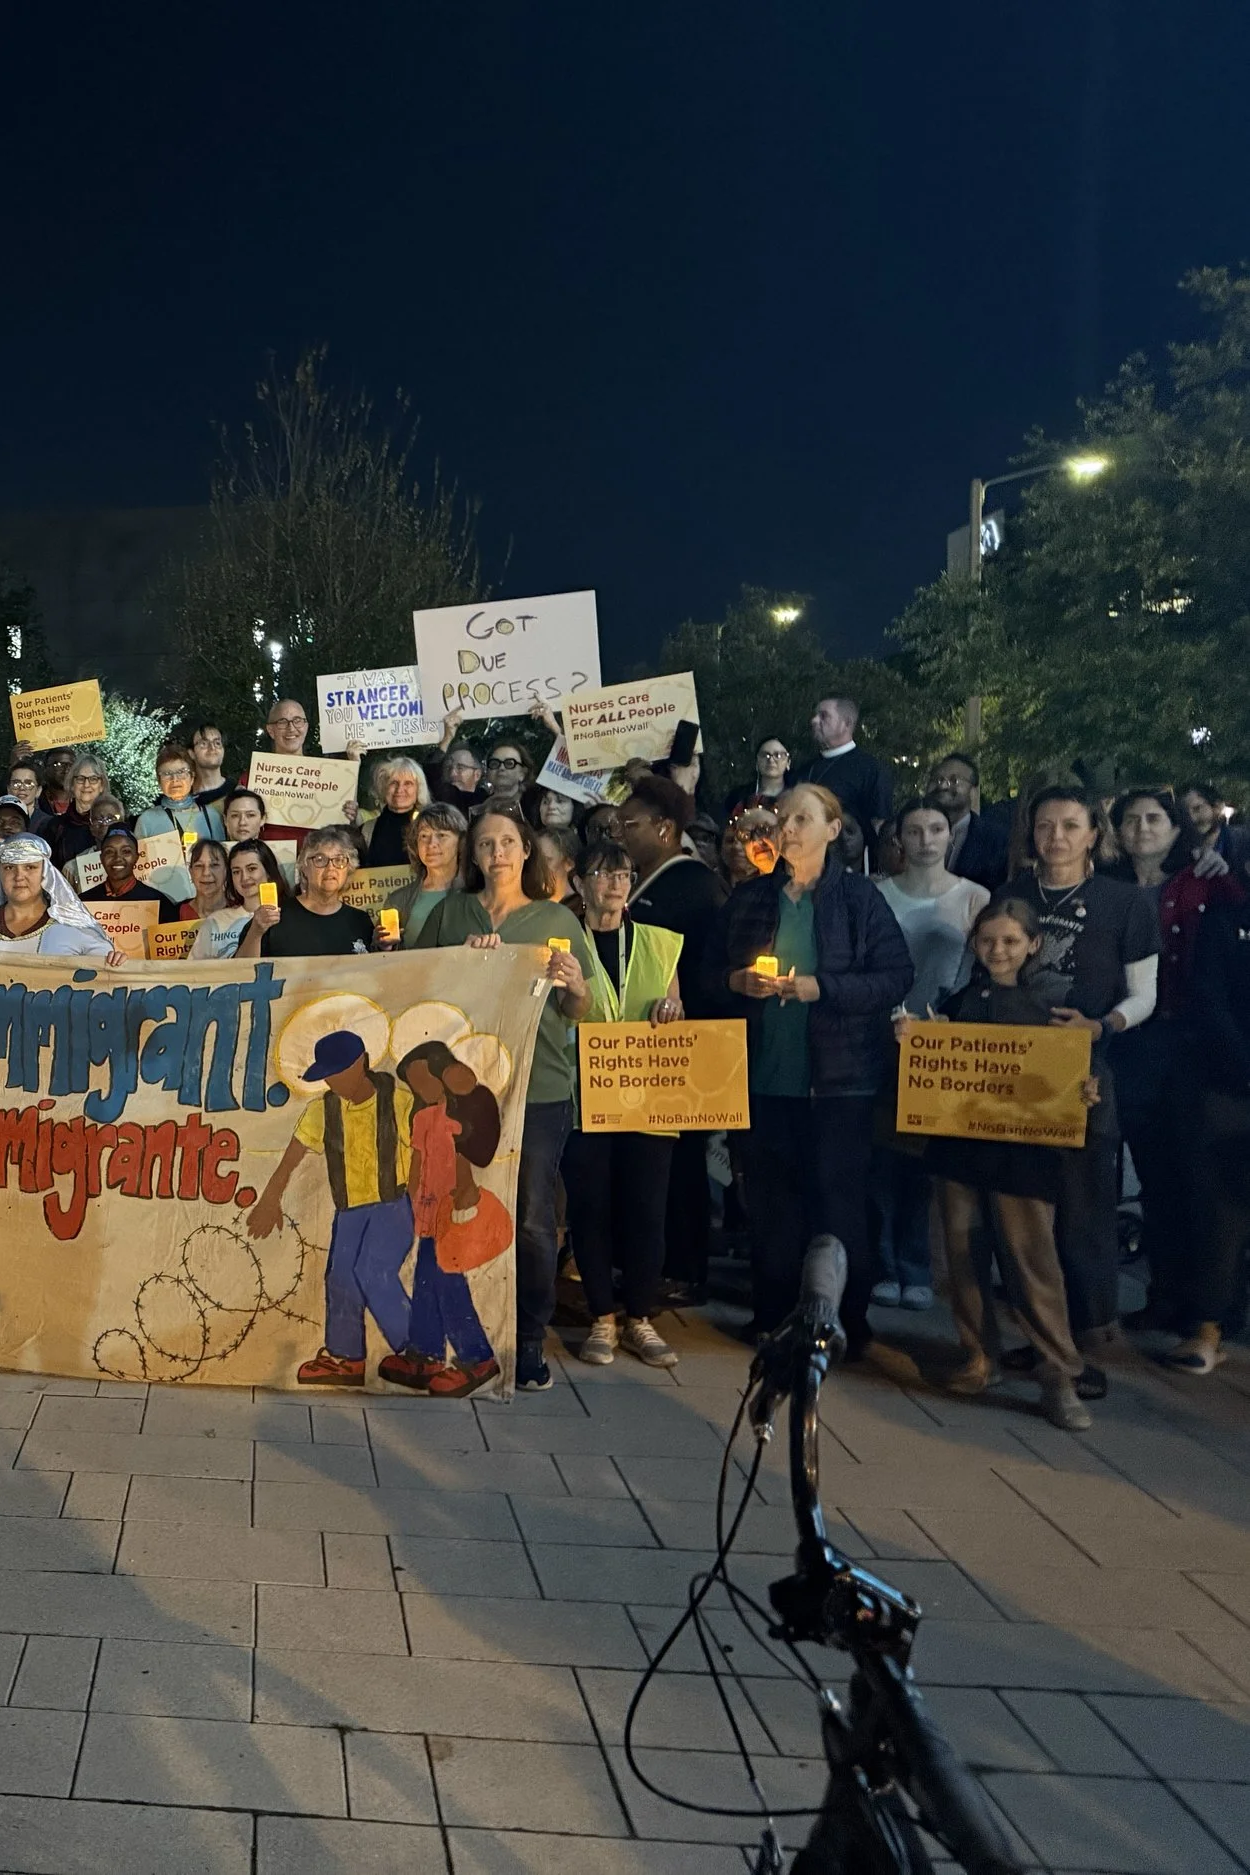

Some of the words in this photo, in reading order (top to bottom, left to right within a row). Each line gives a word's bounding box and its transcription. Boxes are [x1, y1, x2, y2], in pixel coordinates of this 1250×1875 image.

[466, 611, 538, 640] GOT
[458, 650, 507, 674] DUE
[362, 671, 397, 687] WAS
[326, 684, 410, 708] STRANGER
[568, 699, 615, 716] Nurses
[617, 692, 650, 706] Care
[15, 700, 33, 710] Our
[17, 708, 46, 720] Rights
[47, 703, 71, 714] Have
[18, 721, 32, 731] No
[34, 714, 70, 728] Borders
[325, 706, 353, 725] YOU
[570, 717, 595, 729] For
[596, 710, 626, 725] ALL
[628, 702, 676, 720] People
[390, 717, 439, 737] JESUS
[573, 721, 649, 741] #NoBanNoWall
[51, 729, 103, 745] #NoBanNoWall
[256, 762, 293, 775] Nurses
[296, 766, 321, 777] Care
[254, 774, 273, 785] For
[274, 776, 299, 788] ALL
[300, 779, 339, 792] People
[253, 787, 315, 800] #NoBanNoWall
[85, 873, 104, 885] For
[351, 880, 365, 890] ur
[342, 893, 384, 907] Rights
[94, 911, 121, 921] Care
[154, 933, 179, 944] Our
[588, 1036, 620, 1050] Our
[910, 1035, 945, 1049] Our
[589, 1055, 643, 1071] Rights
[648, 1054, 690, 1067] Have
[909, 1054, 968, 1073] Rights
[974, 1058, 1022, 1075] Have
[589, 1074, 614, 1089] No
[619, 1073, 686, 1088] Borders
[908, 1074, 934, 1090] No
[940, 1075, 1015, 1096] Borders
[648, 1112, 743, 1124] #NoBanNoWall
[967, 1119, 1077, 1140] #NoBanNoWall
